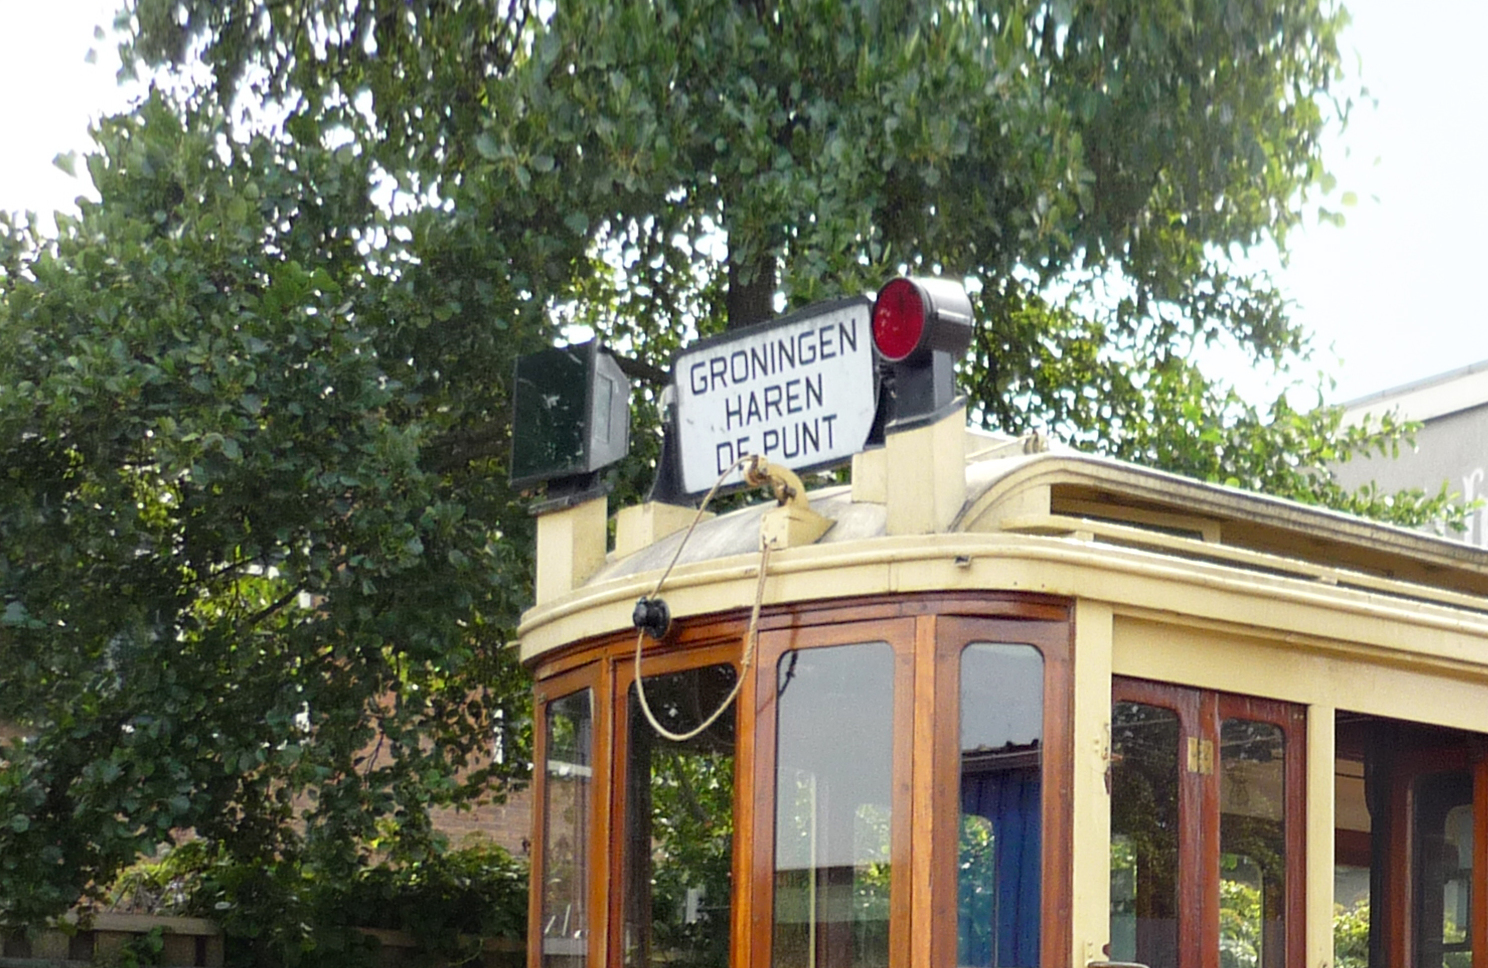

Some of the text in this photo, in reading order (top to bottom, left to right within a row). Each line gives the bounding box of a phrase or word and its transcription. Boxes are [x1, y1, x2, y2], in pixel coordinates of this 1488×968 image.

[690, 318, 857, 396] GRONINGEN
[725, 373, 823, 430] HAREN
[716, 413, 837, 476] DE PUNT
